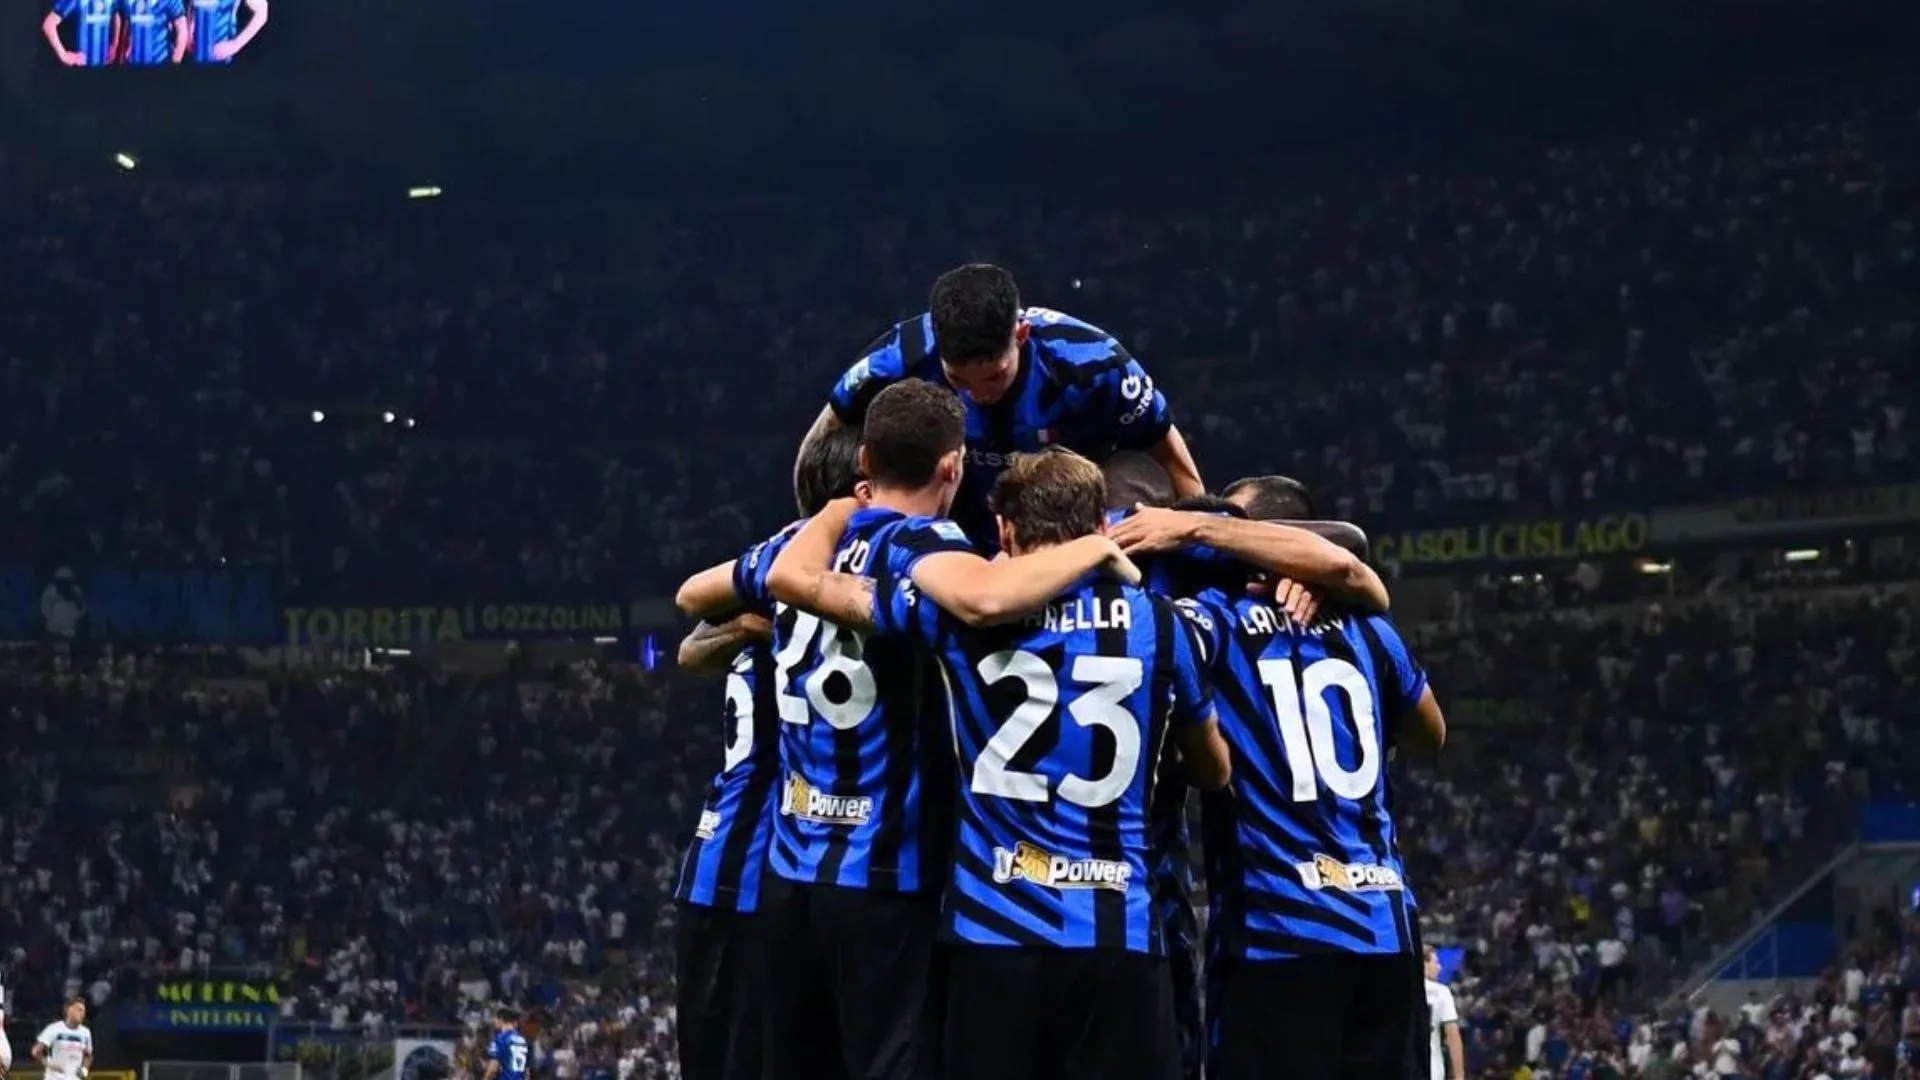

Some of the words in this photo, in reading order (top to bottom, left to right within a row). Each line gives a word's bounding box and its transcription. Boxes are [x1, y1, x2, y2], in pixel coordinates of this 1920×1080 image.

[1495, 512, 1647, 560] CISLAGO
[482, 603, 622, 631] GOZZOLINA
[971, 649, 1143, 808] 23
[1257, 657, 1379, 802] 10
[808, 785, 873, 819] Power
[1048, 855, 1132, 890] Power
